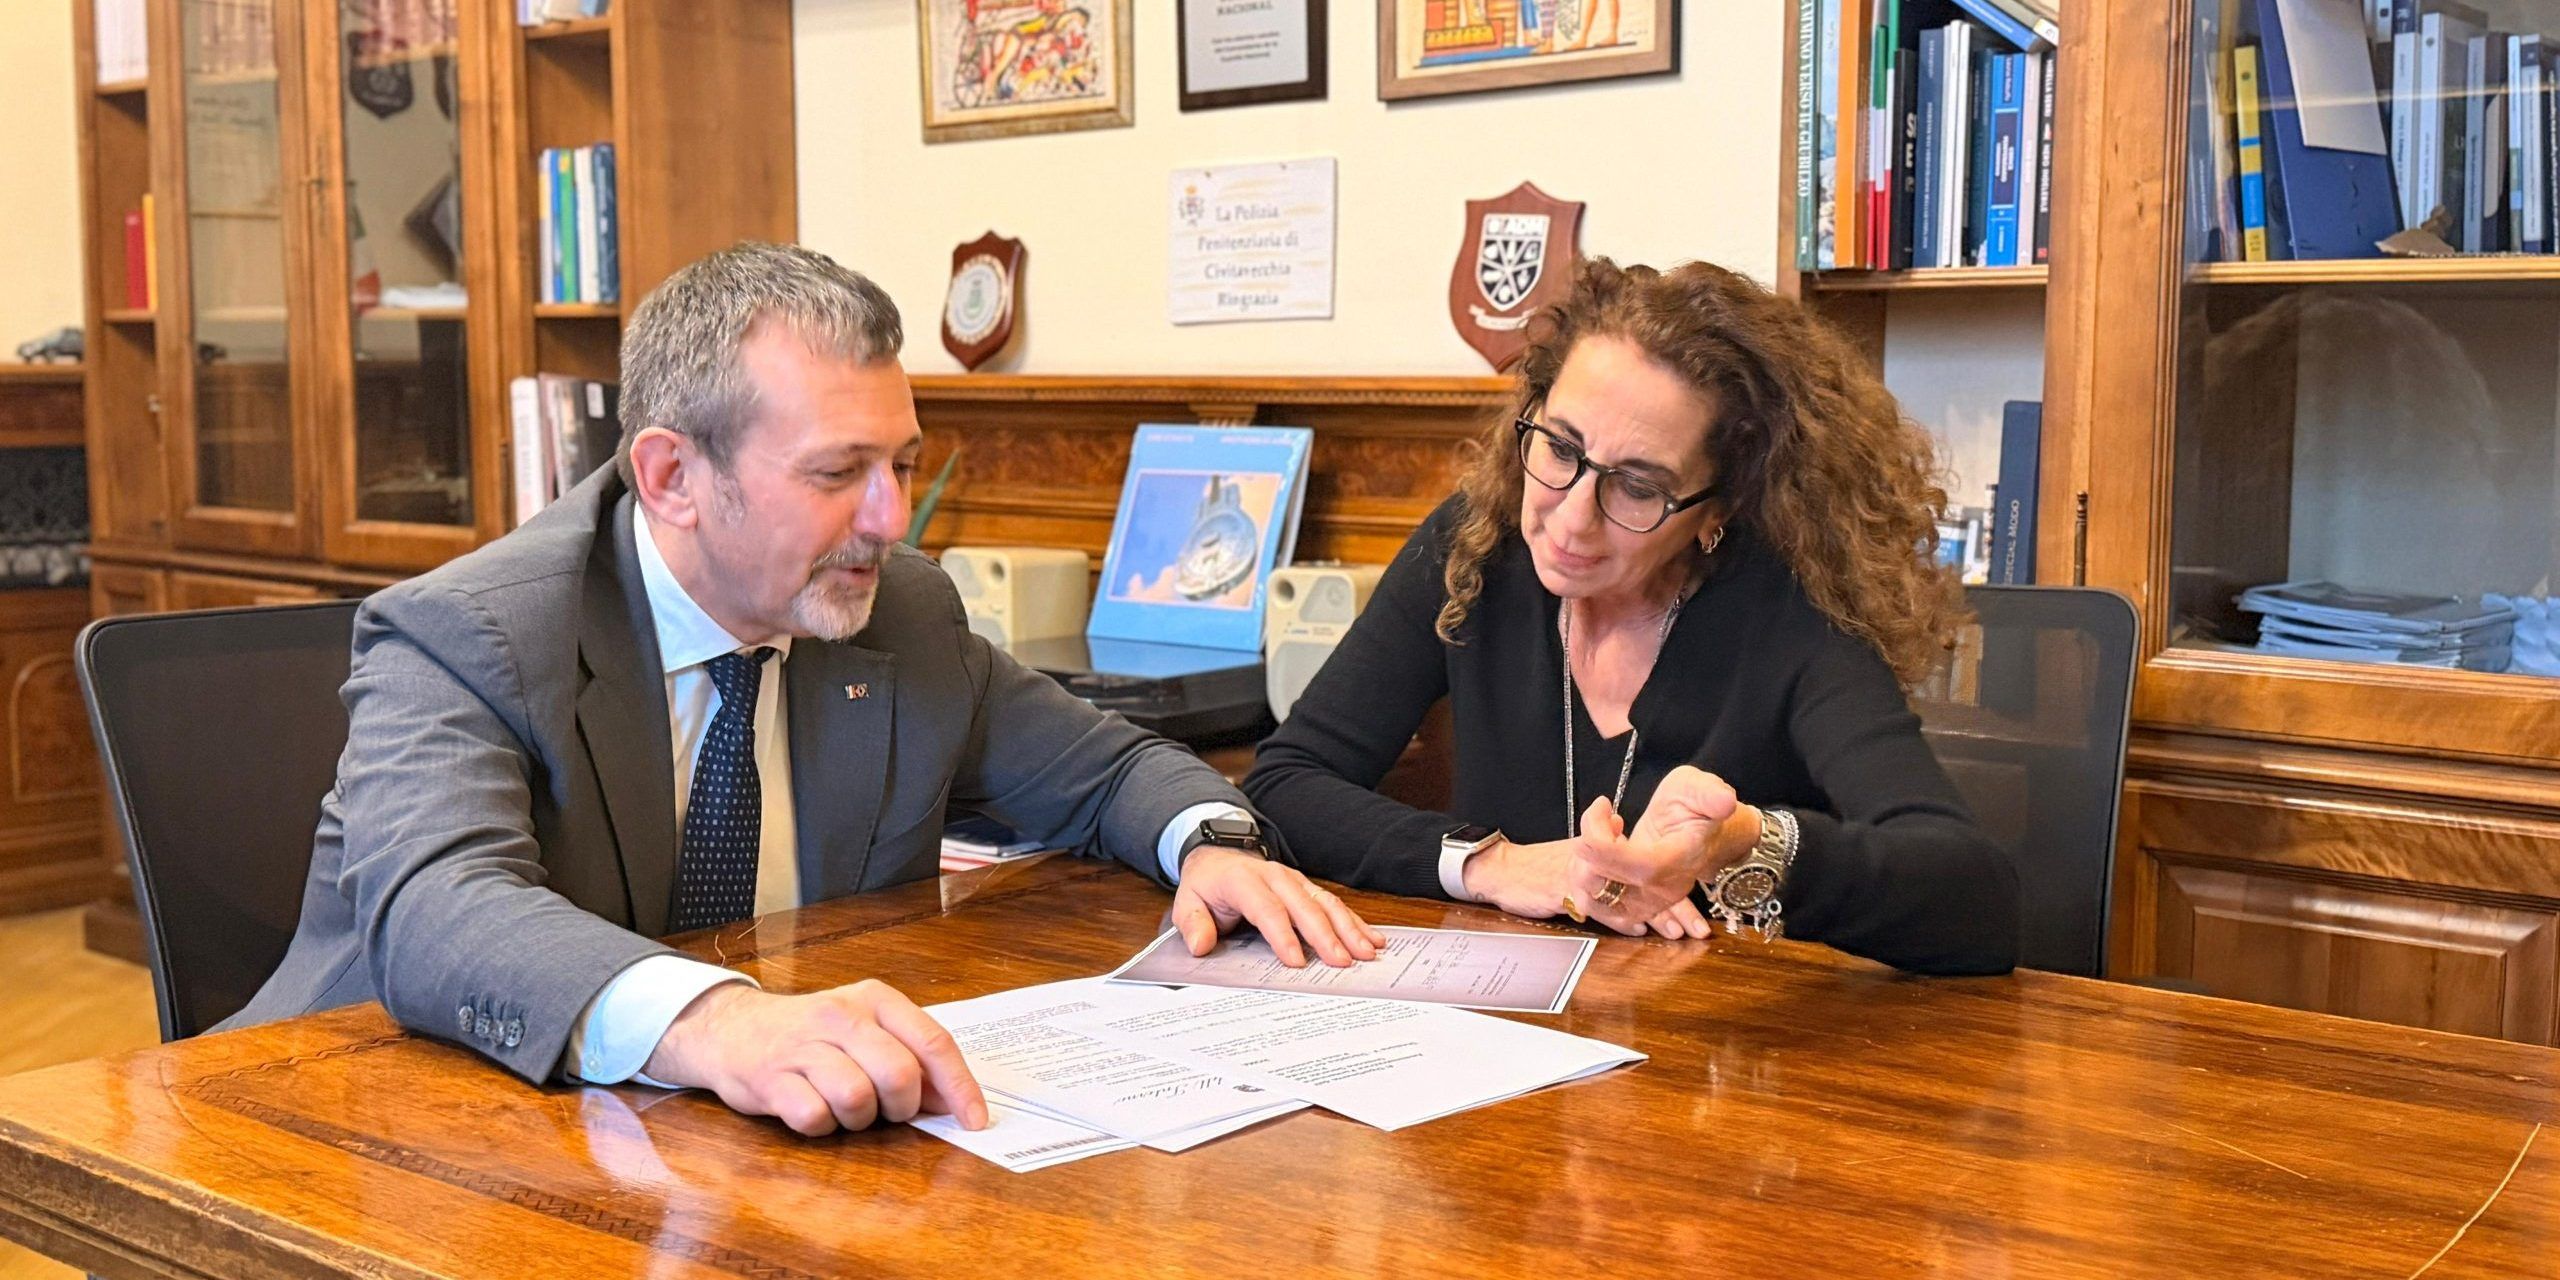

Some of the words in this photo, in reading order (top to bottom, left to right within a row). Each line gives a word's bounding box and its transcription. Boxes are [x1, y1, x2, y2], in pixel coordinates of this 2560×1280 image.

[1798, 63, 1814, 108] VERSO
[1798, 112, 1813, 127] IL
[1797, 130, 1812, 197] GIUBILEO
[1216, 206, 1230, 222] La
[1235, 204, 1279, 221] Polizia
[1198, 235, 1281, 251] Penitenziaria
[1284, 231, 1299, 247] di
[1204, 262, 1291, 280] Civitavecchia
[1218, 292, 1279, 313] Ringrazia
